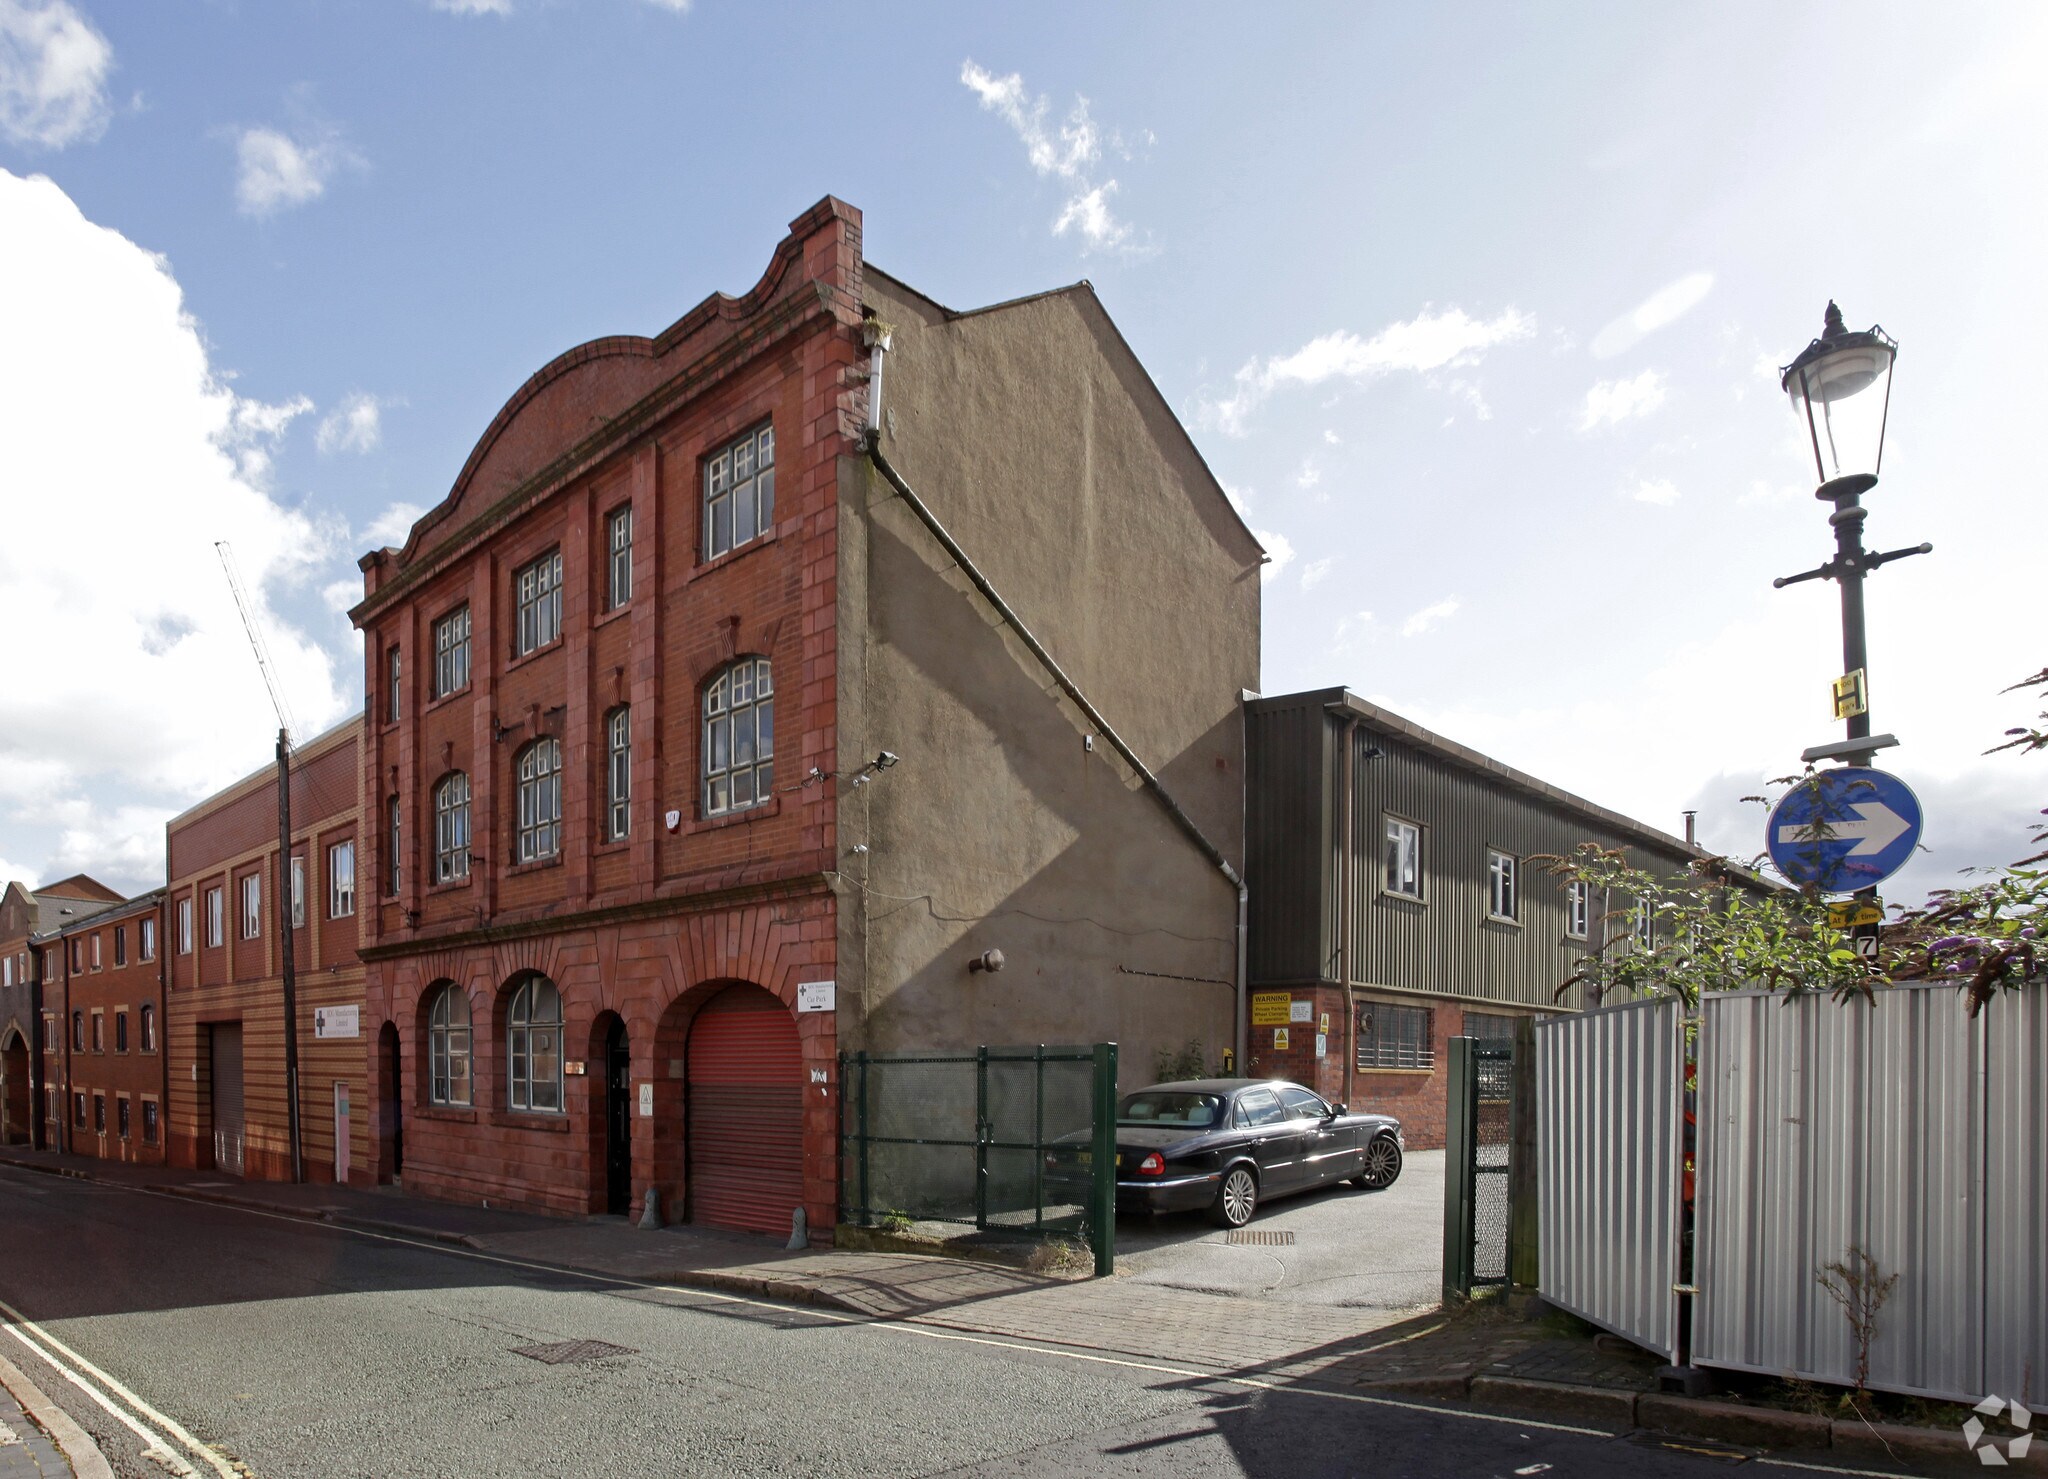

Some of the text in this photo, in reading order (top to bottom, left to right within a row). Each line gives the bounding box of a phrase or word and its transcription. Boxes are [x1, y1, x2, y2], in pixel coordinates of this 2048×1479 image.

[1833, 675, 1860, 717] H
[1861, 912, 1878, 920] time
[1860, 938, 1874, 954] 7
